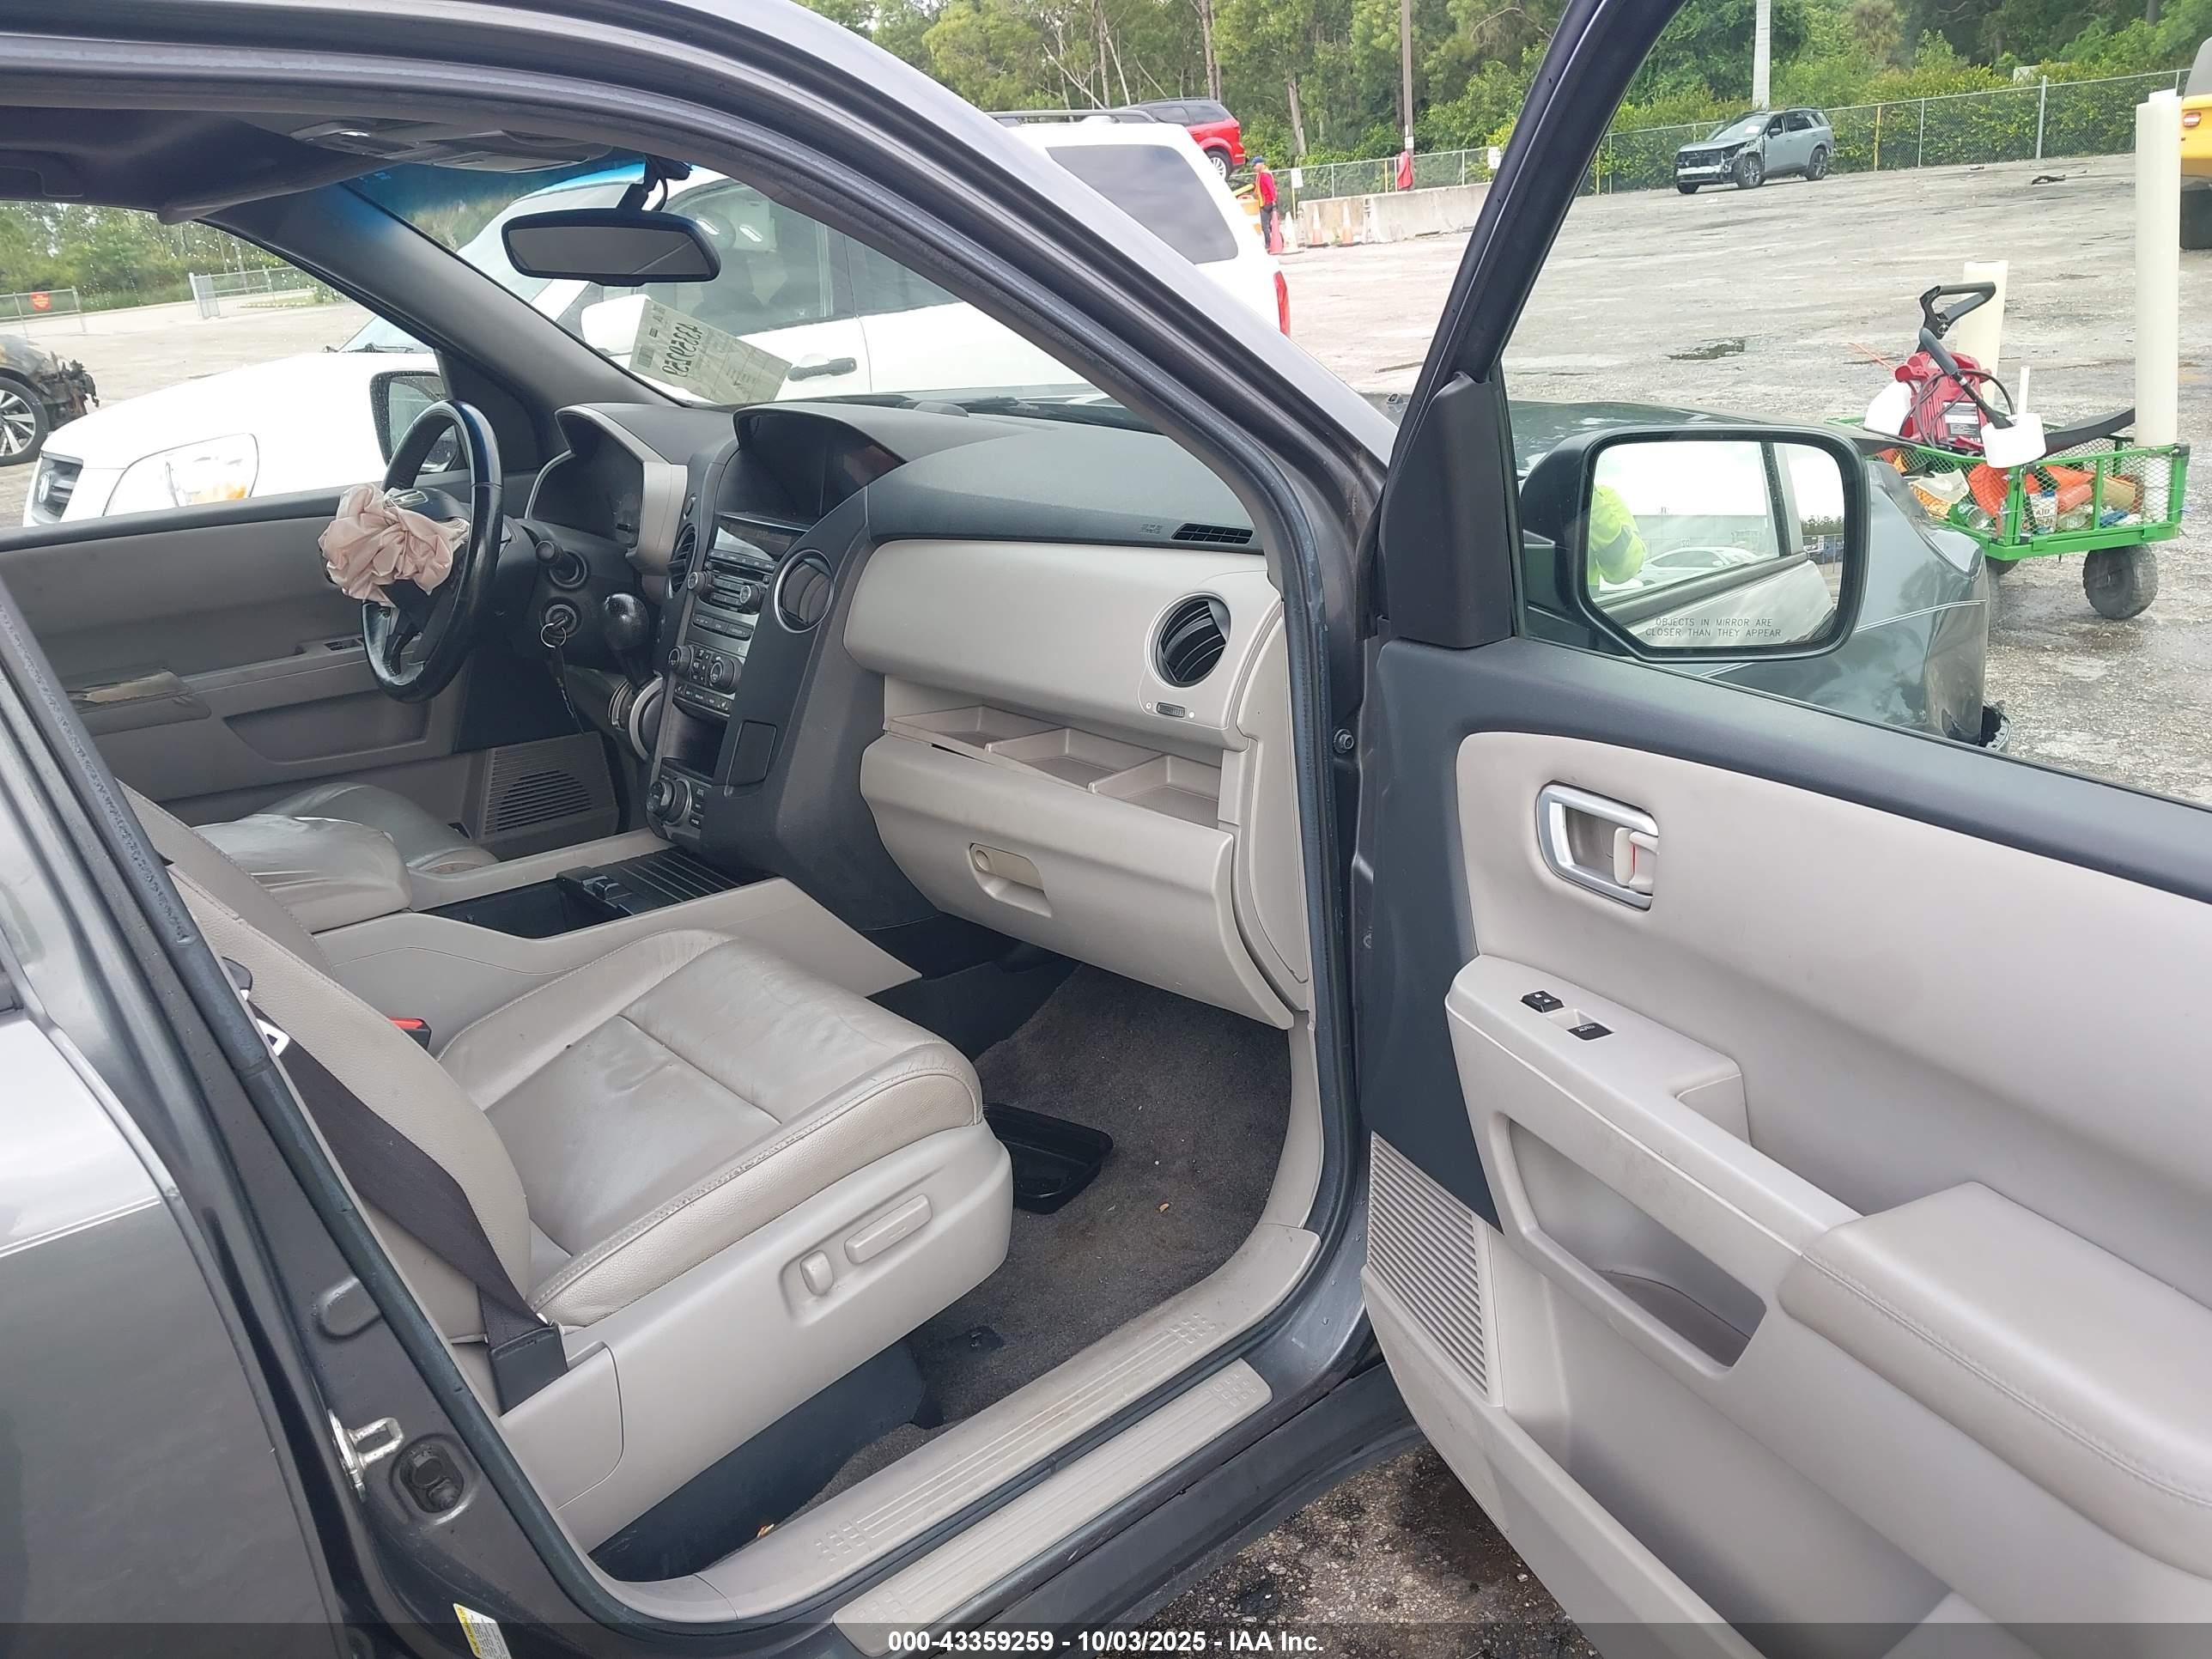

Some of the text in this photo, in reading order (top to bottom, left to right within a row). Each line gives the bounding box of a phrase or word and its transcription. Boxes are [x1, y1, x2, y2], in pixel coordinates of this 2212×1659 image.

[1656, 617, 1773, 627] OBJECTS IN MIRROR ARE
[1645, 628, 1782, 637] CLOSER THAN THEY APPEAR
